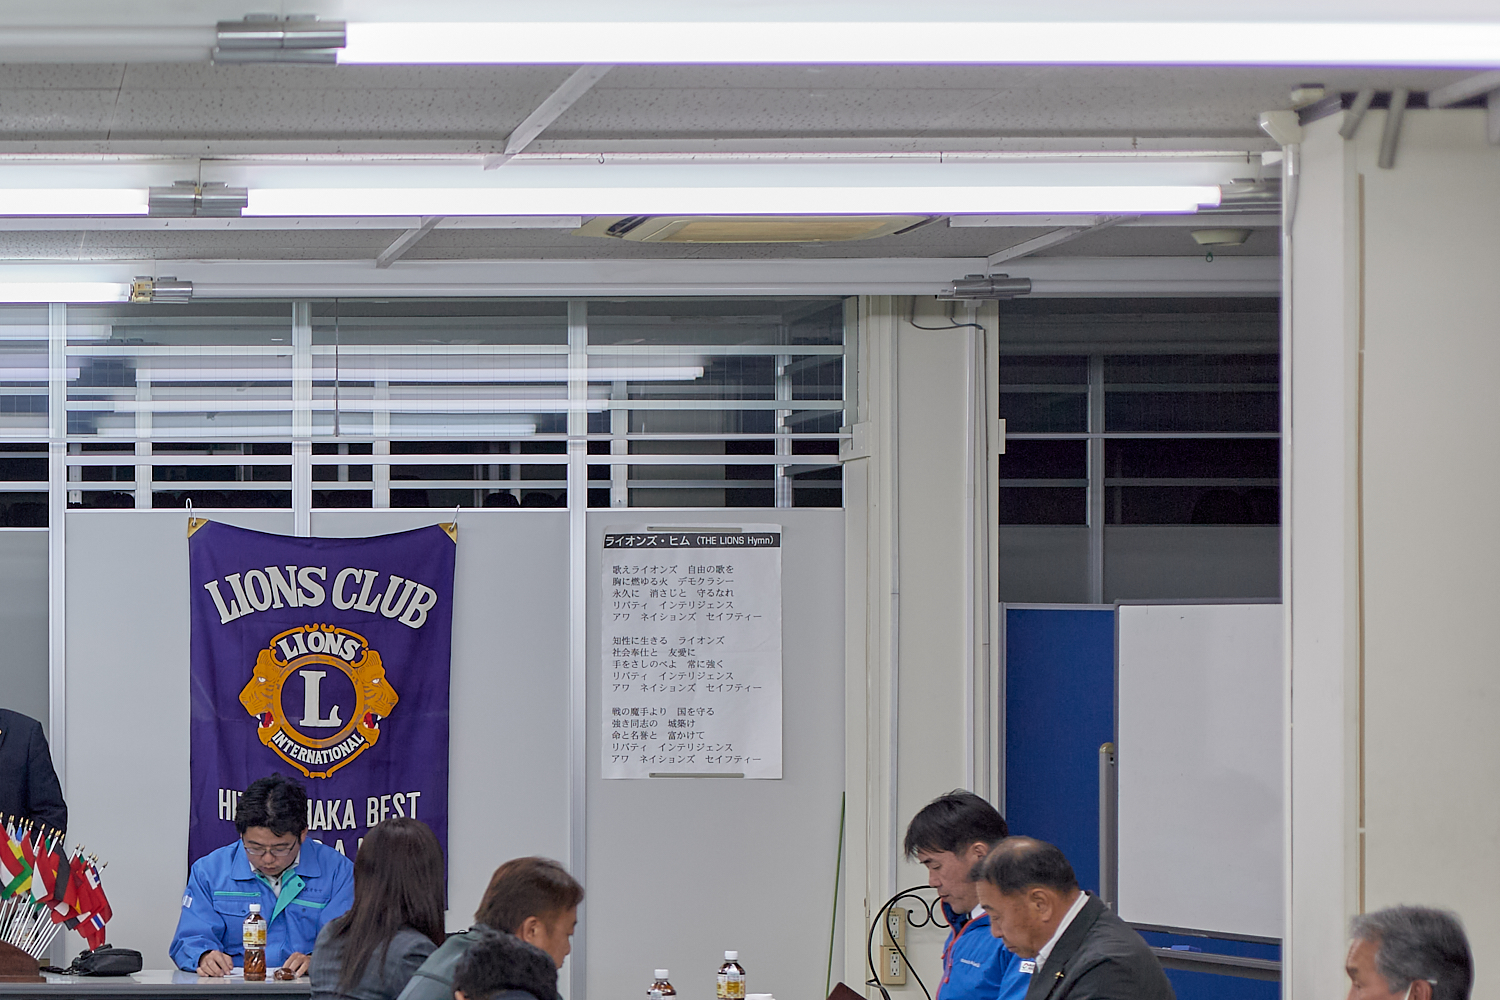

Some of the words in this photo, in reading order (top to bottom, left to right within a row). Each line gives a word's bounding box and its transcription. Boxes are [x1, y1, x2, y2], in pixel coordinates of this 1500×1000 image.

[719, 536, 745, 544] LIONS
[612, 565, 677, 574] 歌えライオンズ
[688, 565, 734, 574] 自由の歌を
[678, 577, 734, 586] デモクラシー
[204, 566, 327, 624] LIONS
[332, 567, 438, 629] CLUB
[612, 589, 639, 598] 永久に
[650, 589, 687, 598] 消さじと
[697, 589, 734, 598] 守るなれ
[613, 601, 647, 609] リバティ
[659, 601, 734, 609] インテリジェンス
[613, 612, 630, 622] アワ
[641, 612, 696, 622] ネイションズ
[706, 612, 762, 622] セイフティー
[613, 636, 668, 645] 知性に生きる
[679, 636, 725, 645] ライオンズ
[277, 631, 361, 661] LIONS
[613, 660, 677, 669] 手をさしのべよ
[687, 660, 723, 669] 常に強く
[613, 672, 647, 680] リバティ
[659, 672, 734, 680] インテリジェンス
[612, 683, 630, 692] アワ
[640, 683, 696, 692] ネイションズ
[706, 683, 762, 692] セイフティー
[299, 670, 342, 727] L
[677, 707, 715, 716] 国を守る
[612, 719, 658, 728] 強き同志の
[668, 731, 705, 740] 富かけて
[272, 730, 364, 764] INTERNATIONAL
[612, 743, 647, 751] リバティ
[659, 743, 733, 751] インテリジェンス
[612, 755, 629, 764] アワ
[640, 755, 695, 764] ネイションズ
[705, 755, 761, 764] セイフティー
[367, 792, 420, 828] BEST
